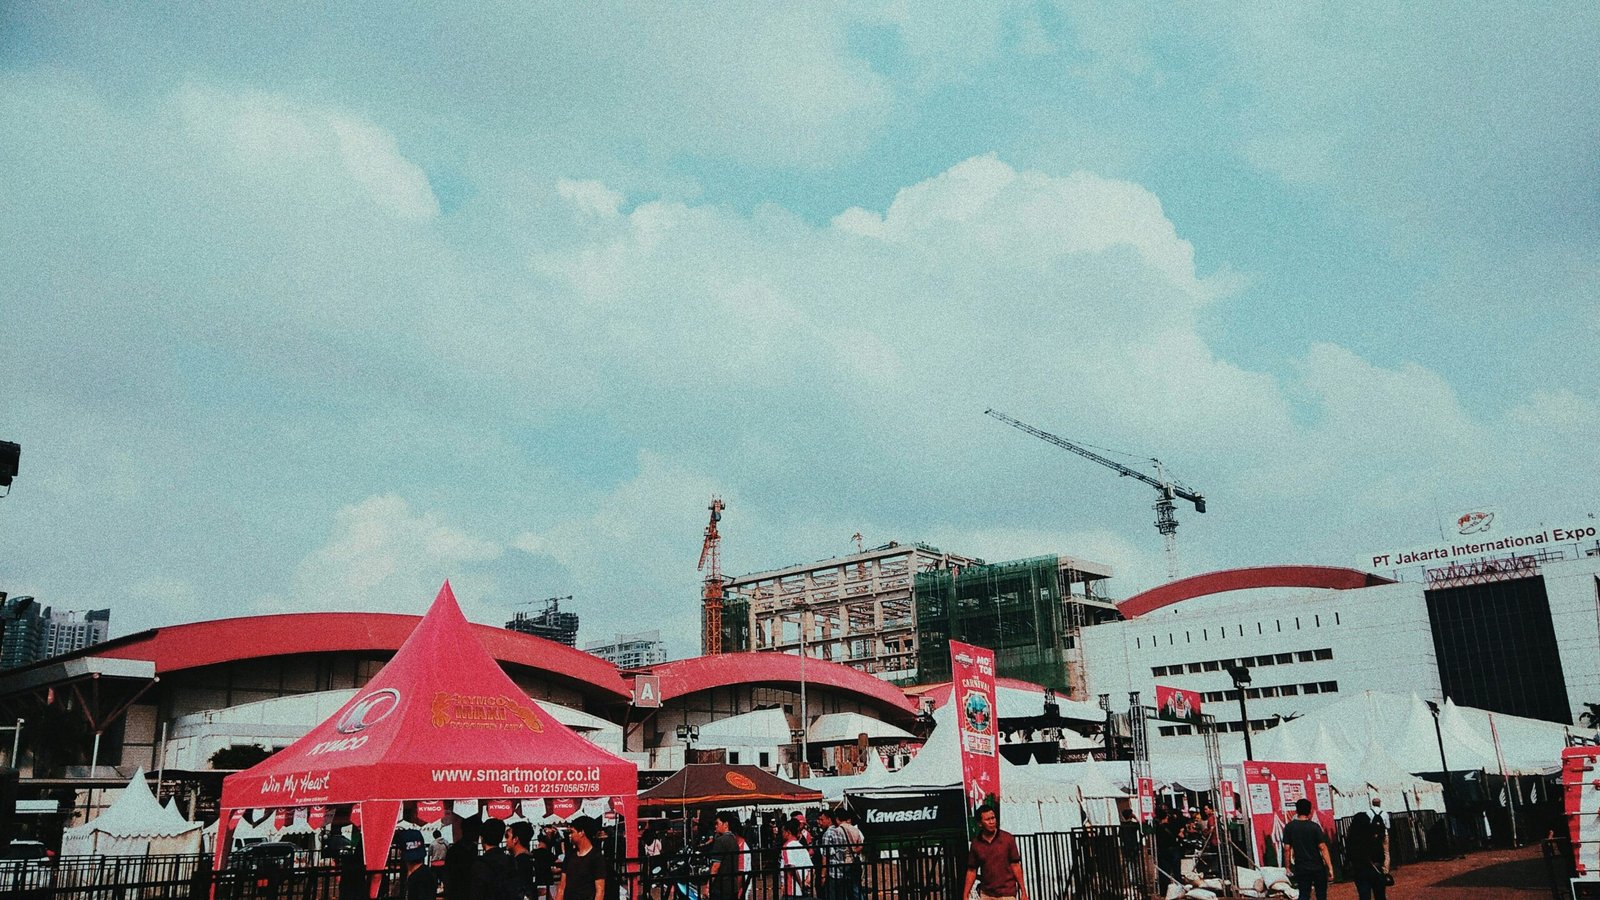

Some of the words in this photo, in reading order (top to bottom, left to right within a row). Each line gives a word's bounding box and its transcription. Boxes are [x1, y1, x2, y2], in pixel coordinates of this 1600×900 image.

[1372, 555, 1390, 567] PT
[1395, 548, 1448, 565] Jakarta
[1451, 531, 1548, 557] International
[1553, 526, 1596, 542] Expo
[641, 683, 654, 700] A
[306, 735, 369, 757] KYMCO
[431, 767, 600, 782] www.smartmotor.co.id
[261, 774, 281, 794] Win
[282, 774, 298, 799] My
[300, 771, 331, 794] Heart
[502, 784, 522, 794] Telp.
[524, 784, 538, 793] 021
[540, 783, 600, 793] 22157056/57/58
[866, 805, 939, 824] Kawasaki
